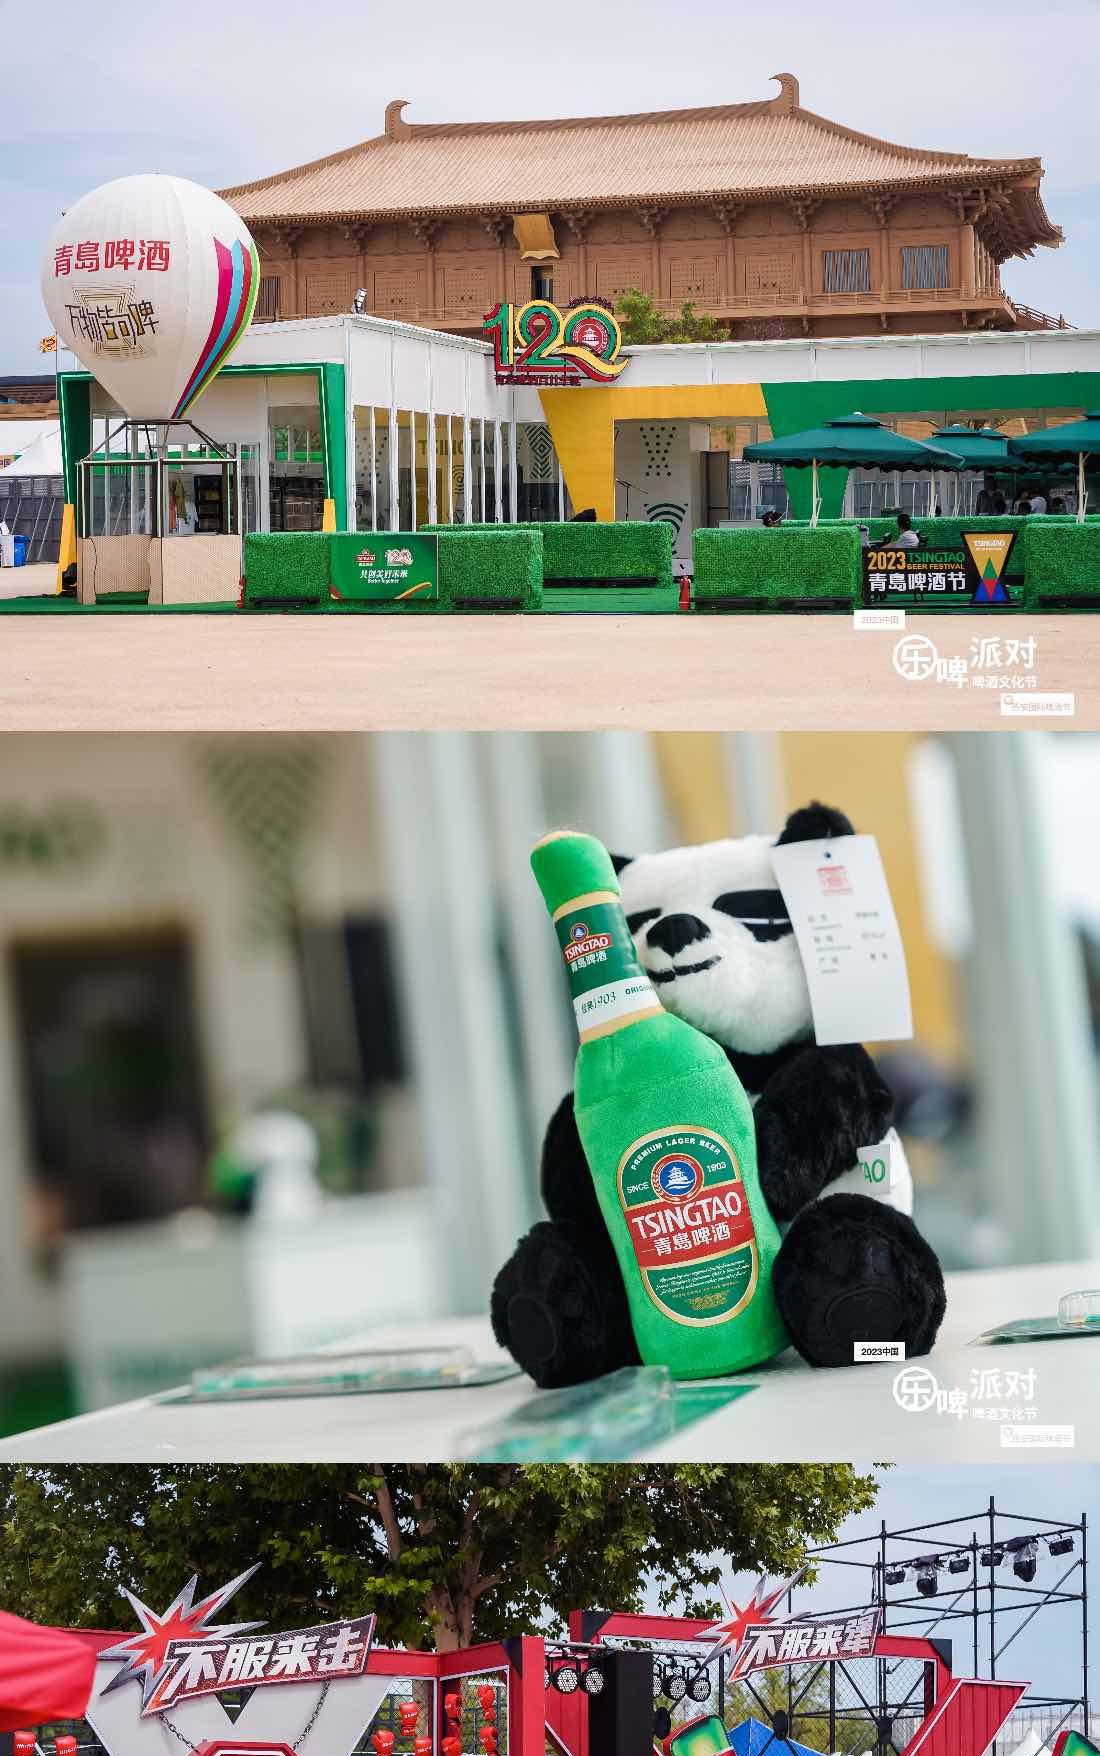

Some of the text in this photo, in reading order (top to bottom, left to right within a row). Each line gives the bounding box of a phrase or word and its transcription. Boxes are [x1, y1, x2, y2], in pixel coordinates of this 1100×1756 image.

[867, 551, 965, 570] 2023 TSINGTAO
[564, 936, 609, 960] TSINGTAO
[631, 1137, 721, 1170] PREMIUM LAGER BEER
[707, 1161, 727, 1173] 1903
[861, 1159, 886, 1183] AO
[626, 1181, 650, 1194] SINCE
[631, 1191, 742, 1239] TSINGTAO
[160, 1627, 364, 1701] 不服来击
